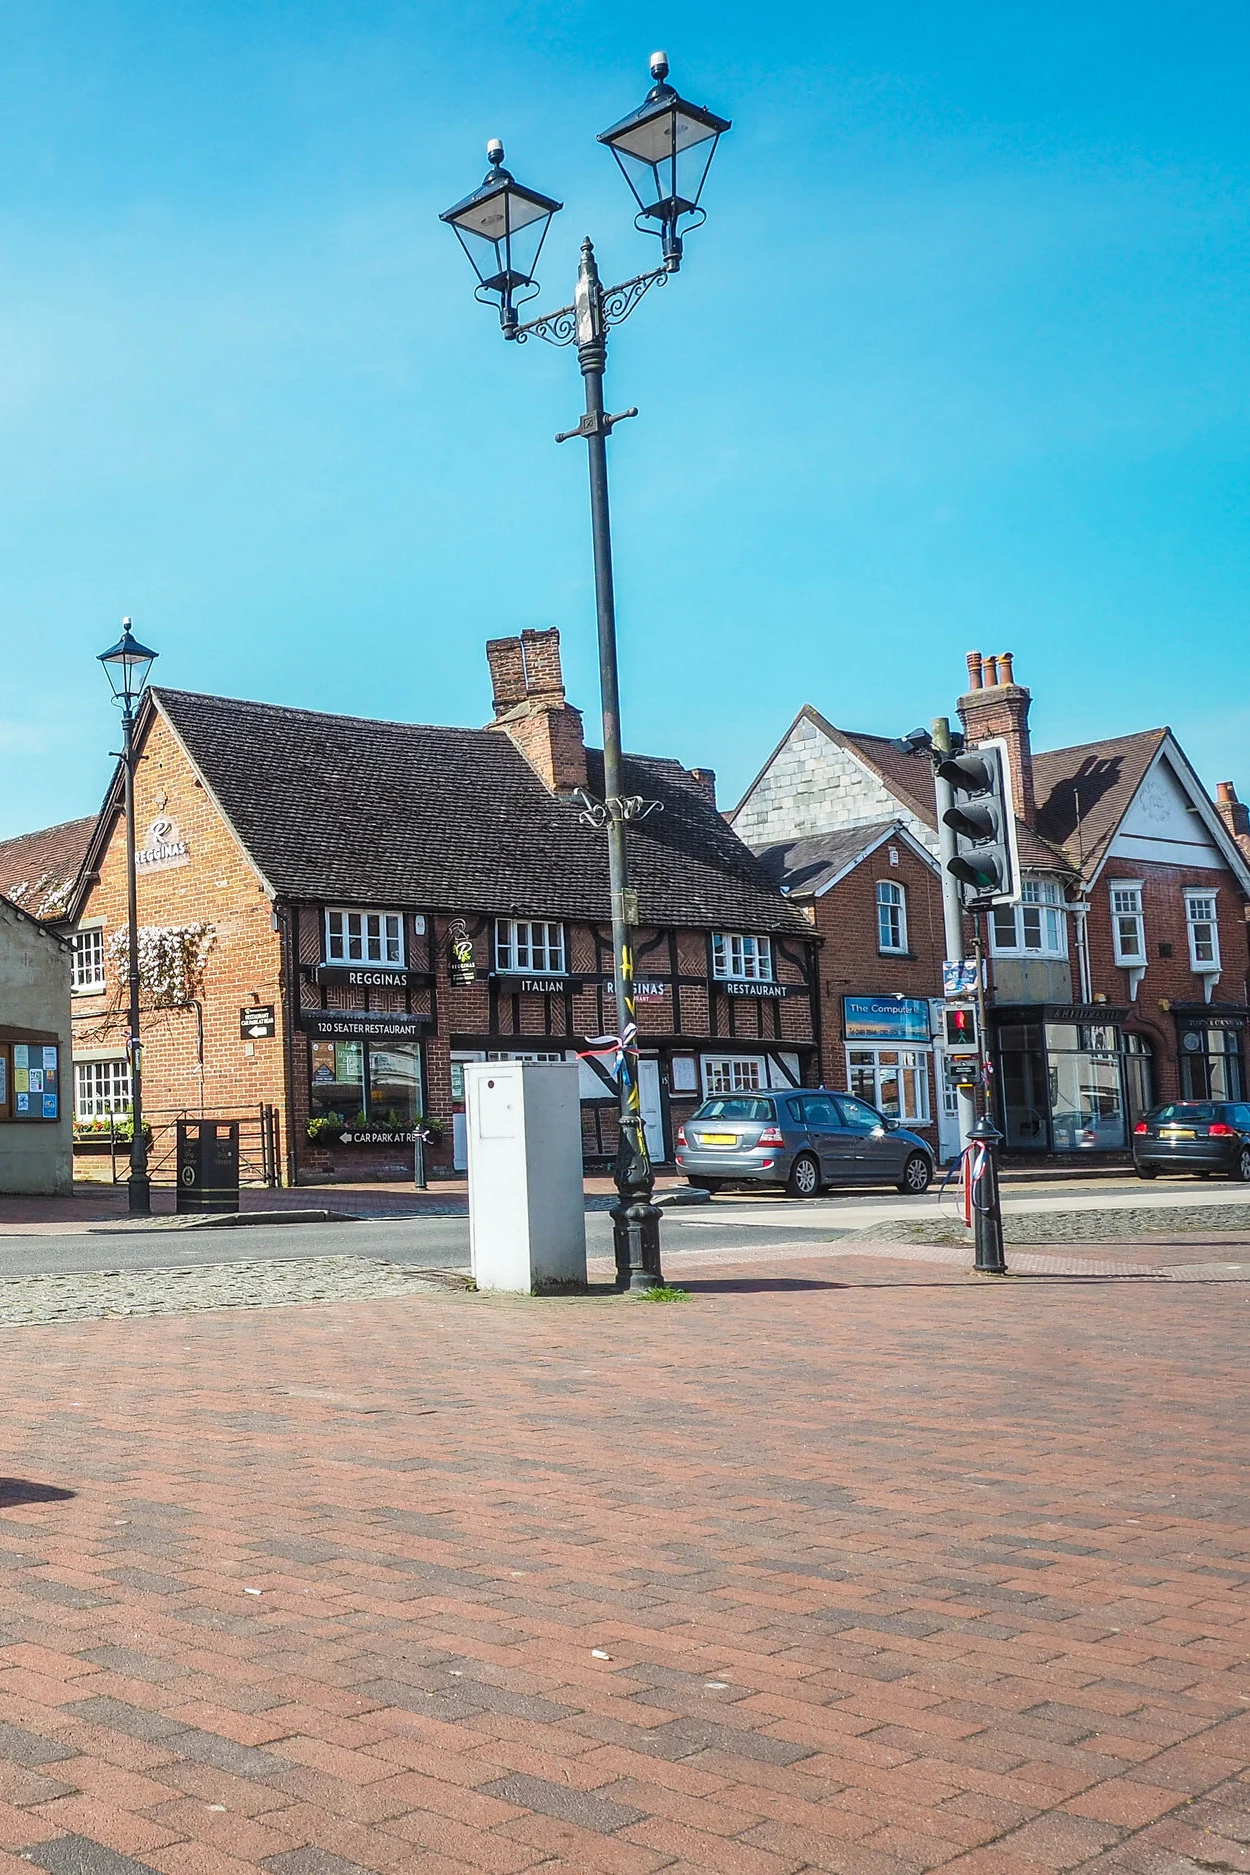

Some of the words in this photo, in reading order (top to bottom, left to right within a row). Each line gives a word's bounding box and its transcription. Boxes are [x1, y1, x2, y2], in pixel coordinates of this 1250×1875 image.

[135, 841, 186, 864] REGGINAS
[349, 972, 408, 986] REGGINAS
[521, 980, 564, 993] ITALIAN
[607, 981, 665, 996] RGINAS
[727, 983, 788, 997] RESTAURANT
[849, 1003, 869, 1013] The
[871, 1004, 913, 1015] Computer
[317, 1022, 333, 1032] 120
[333, 1023, 364, 1034] SEATER
[364, 1024, 417, 1035] RESTAURANT
[353, 1132, 371, 1143] CAR
[372, 1132, 393, 1143] PARK
[394, 1132, 406, 1143] AT
[406, 1132, 417, 1143] RE
